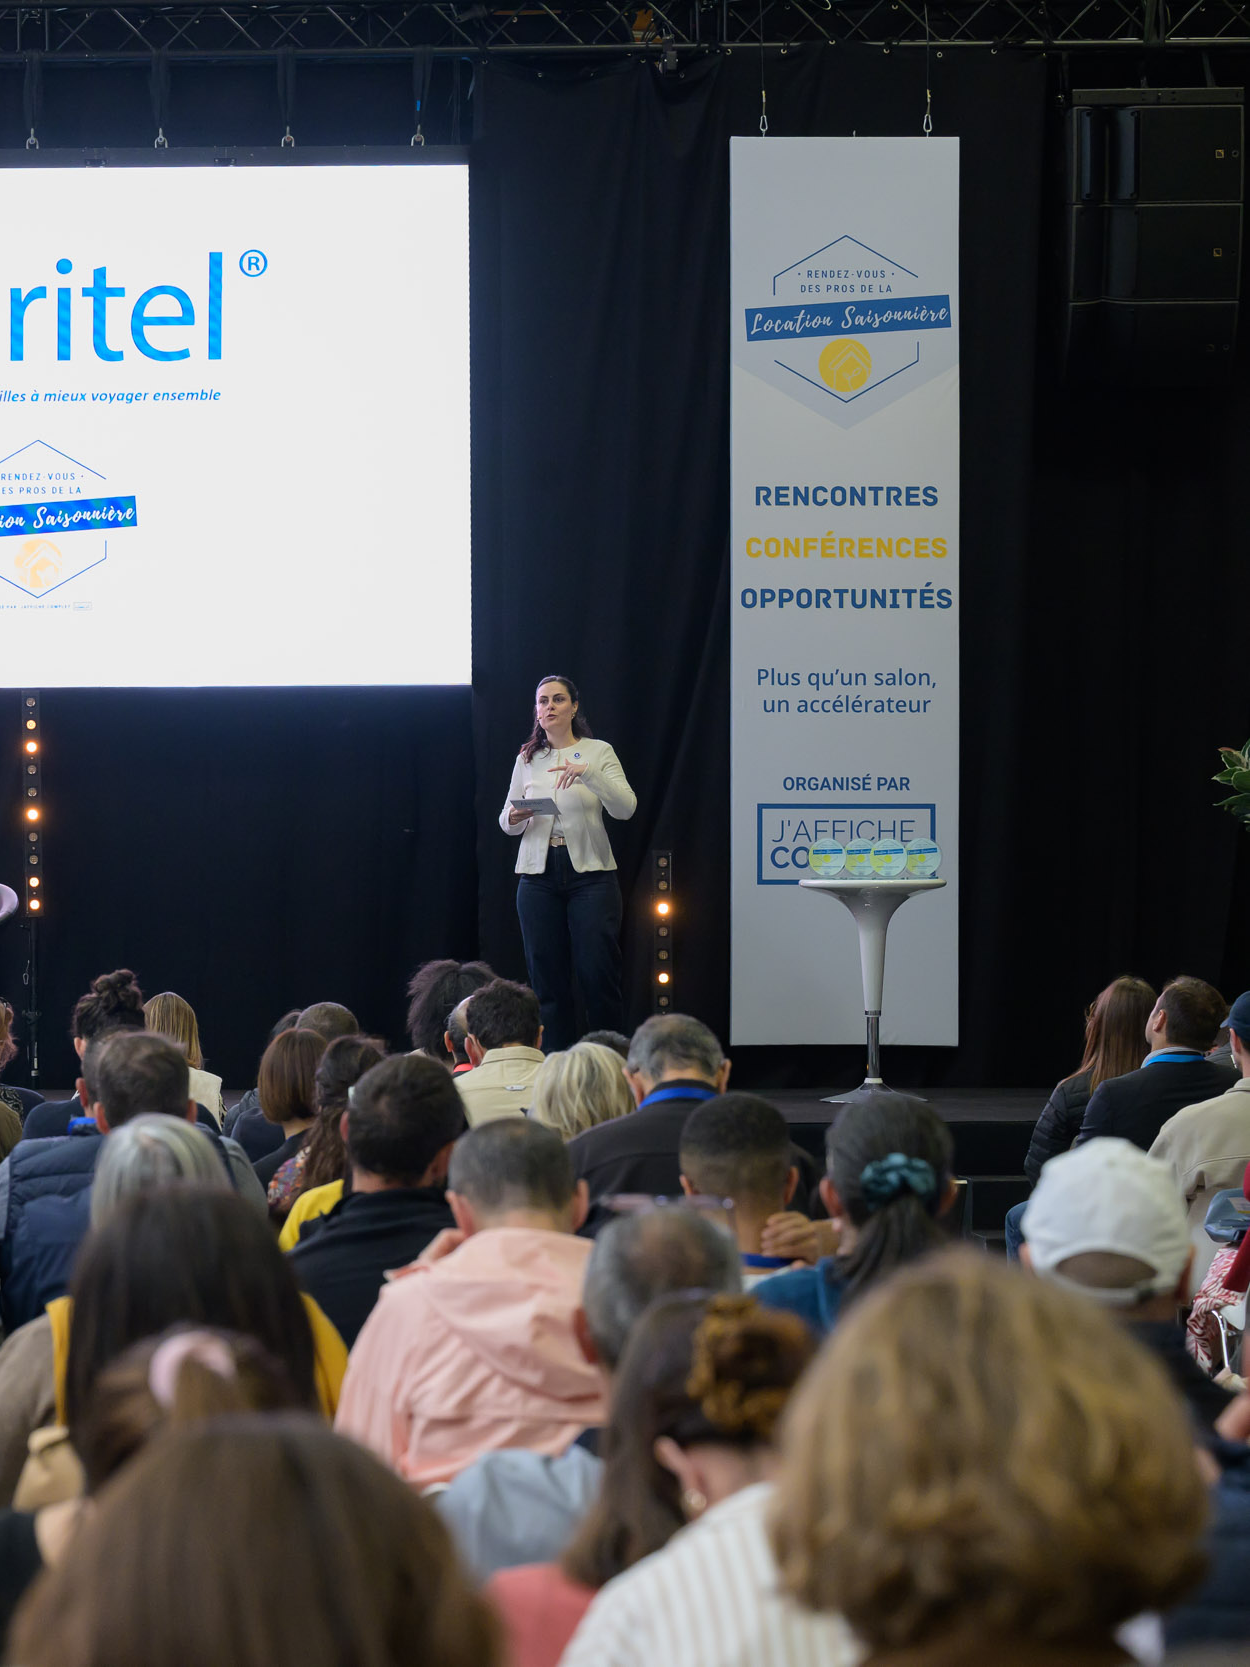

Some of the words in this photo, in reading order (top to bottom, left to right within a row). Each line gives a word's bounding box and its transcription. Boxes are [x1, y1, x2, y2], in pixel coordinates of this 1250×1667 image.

[807, 270, 886, 278] RENDEZ-VOUS
[800, 284, 821, 293] DES
[826, 284, 855, 293] PROS
[860, 284, 874, 293] DE
[879, 284, 892, 293] LA
[750, 310, 833, 335] Location
[841, 306, 948, 329] Saisonnière
[30, 390, 40, 402] à
[44, 390, 87, 402] mieux
[91, 392, 149, 404] voyager
[153, 389, 222, 401] ensemble
[0, 472, 76, 480] RENDEZ-VOUS
[19, 486, 47, 494] PROS
[52, 486, 65, 494] DE
[69, 486, 82, 494] LA
[755, 486, 939, 507] RENCONTRES
[33, 506, 135, 528] Saisonnière
[746, 530, 948, 558] CONFÉRENCES
[740, 582, 952, 609] OPPORTUNITÉS
[757, 668, 800, 686] Plus
[874, 668, 936, 689] salon,
[763, 698, 790, 713] un
[796, 694, 932, 713] accélérateur
[782, 774, 872, 791] ORGANISÉ
[877, 777, 910, 791] PAR
